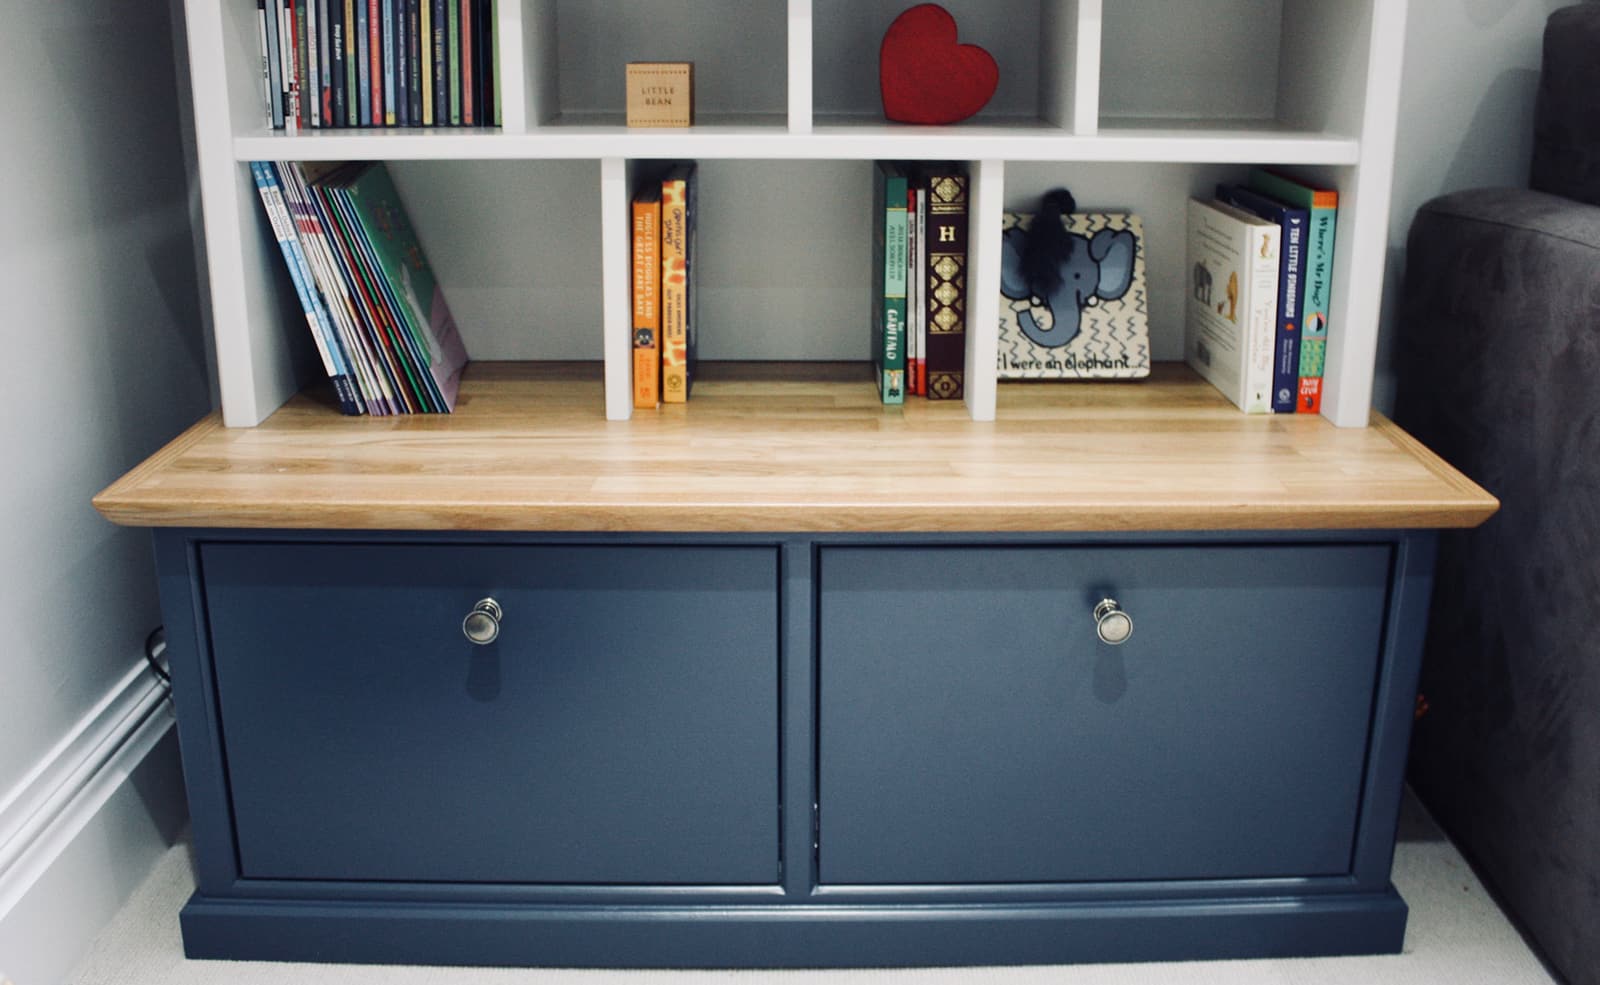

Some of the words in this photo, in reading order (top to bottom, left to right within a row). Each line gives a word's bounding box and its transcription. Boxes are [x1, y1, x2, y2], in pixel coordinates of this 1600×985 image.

[641, 87, 674, 95] LITTLE
[636, 216, 644, 232] THE
[644, 212, 653, 253] HUGLESS
[939, 226, 955, 242] H
[1290, 227, 1300, 244] TEN
[1317, 216, 1329, 259] Where's
[636, 236, 644, 265] GREAT
[1288, 245, 1299, 273] LITTLE
[644, 255, 653, 297] DOUGLAS
[1315, 263, 1325, 277] Mr
[1285, 274, 1297, 318] DINOSAURS
[1312, 281, 1323, 307] Dog?
[645, 301, 653, 319] AND
[1010, 359, 1042, 370] were
[1044, 359, 1062, 371] an
